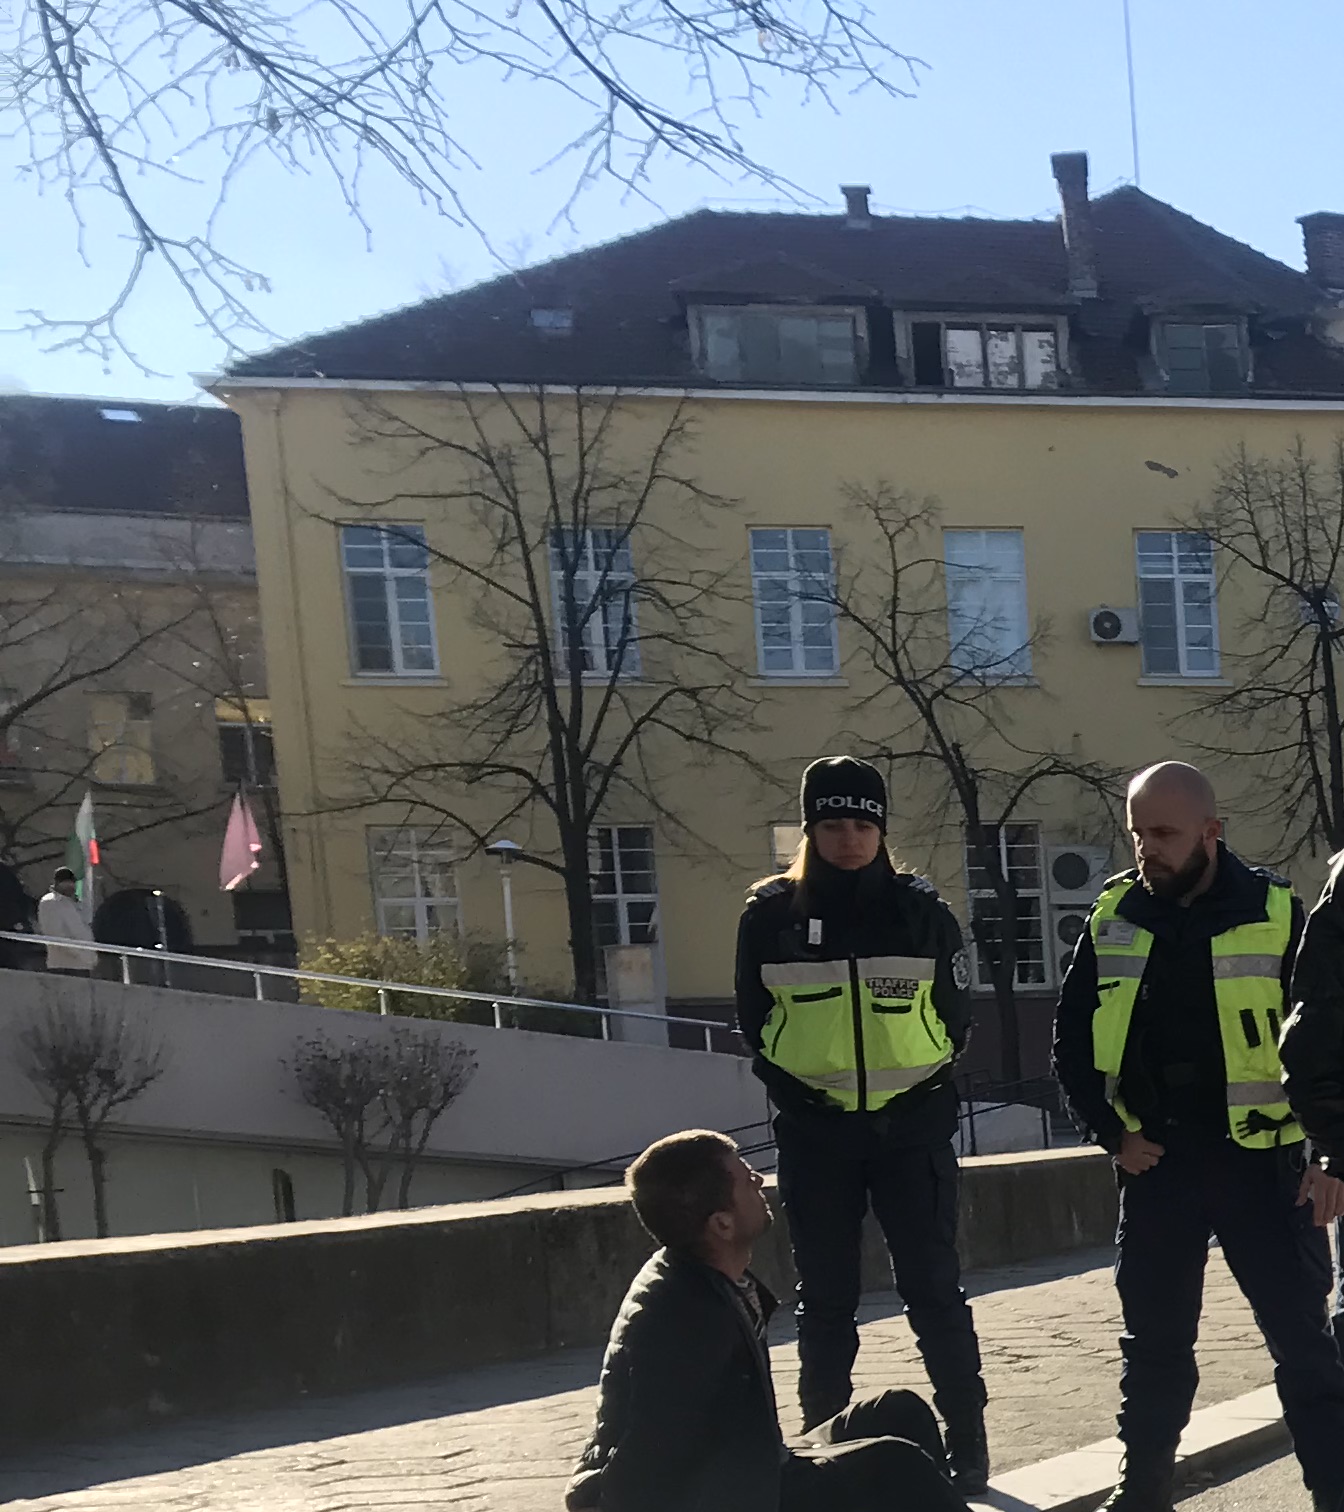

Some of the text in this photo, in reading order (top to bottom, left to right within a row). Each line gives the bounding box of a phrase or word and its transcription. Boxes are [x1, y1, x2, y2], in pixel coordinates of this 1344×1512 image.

[816, 796, 883, 817] POLICE
[867, 978, 917, 990] TRAFFIC
[873, 987, 913, 998] POLICE
